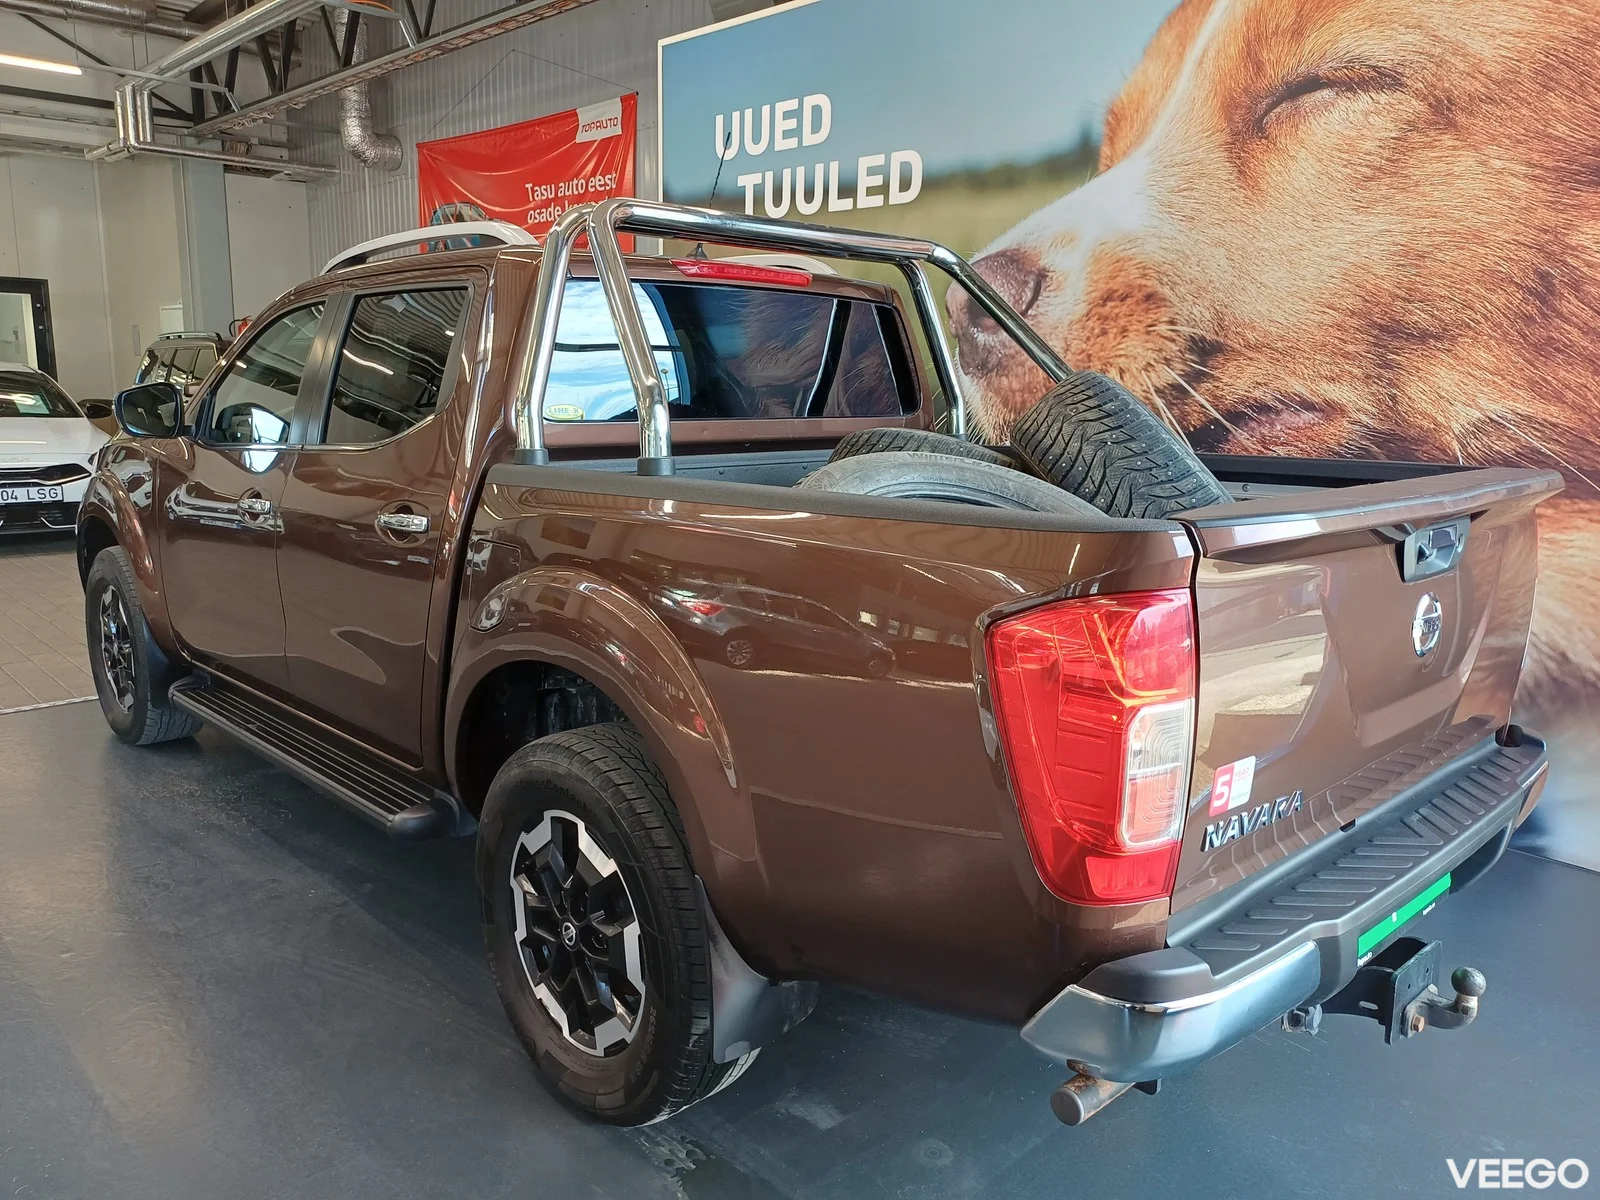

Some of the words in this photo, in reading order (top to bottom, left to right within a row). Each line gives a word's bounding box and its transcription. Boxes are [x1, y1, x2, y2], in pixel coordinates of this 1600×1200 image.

[581, 117, 618, 133] TOPAUTO
[715, 93, 832, 160] UUED
[525, 182, 555, 202] Tasu
[557, 178, 586, 198] auto
[588, 172, 617, 192] eest
[737, 149, 923, 219] TUULED
[527, 203, 562, 225] osade
[1, 490, 18, 501] 04
[27, 488, 58, 500] LSG
[1213, 773, 1231, 808] 5
[1199, 789, 1304, 853] NAVARA
